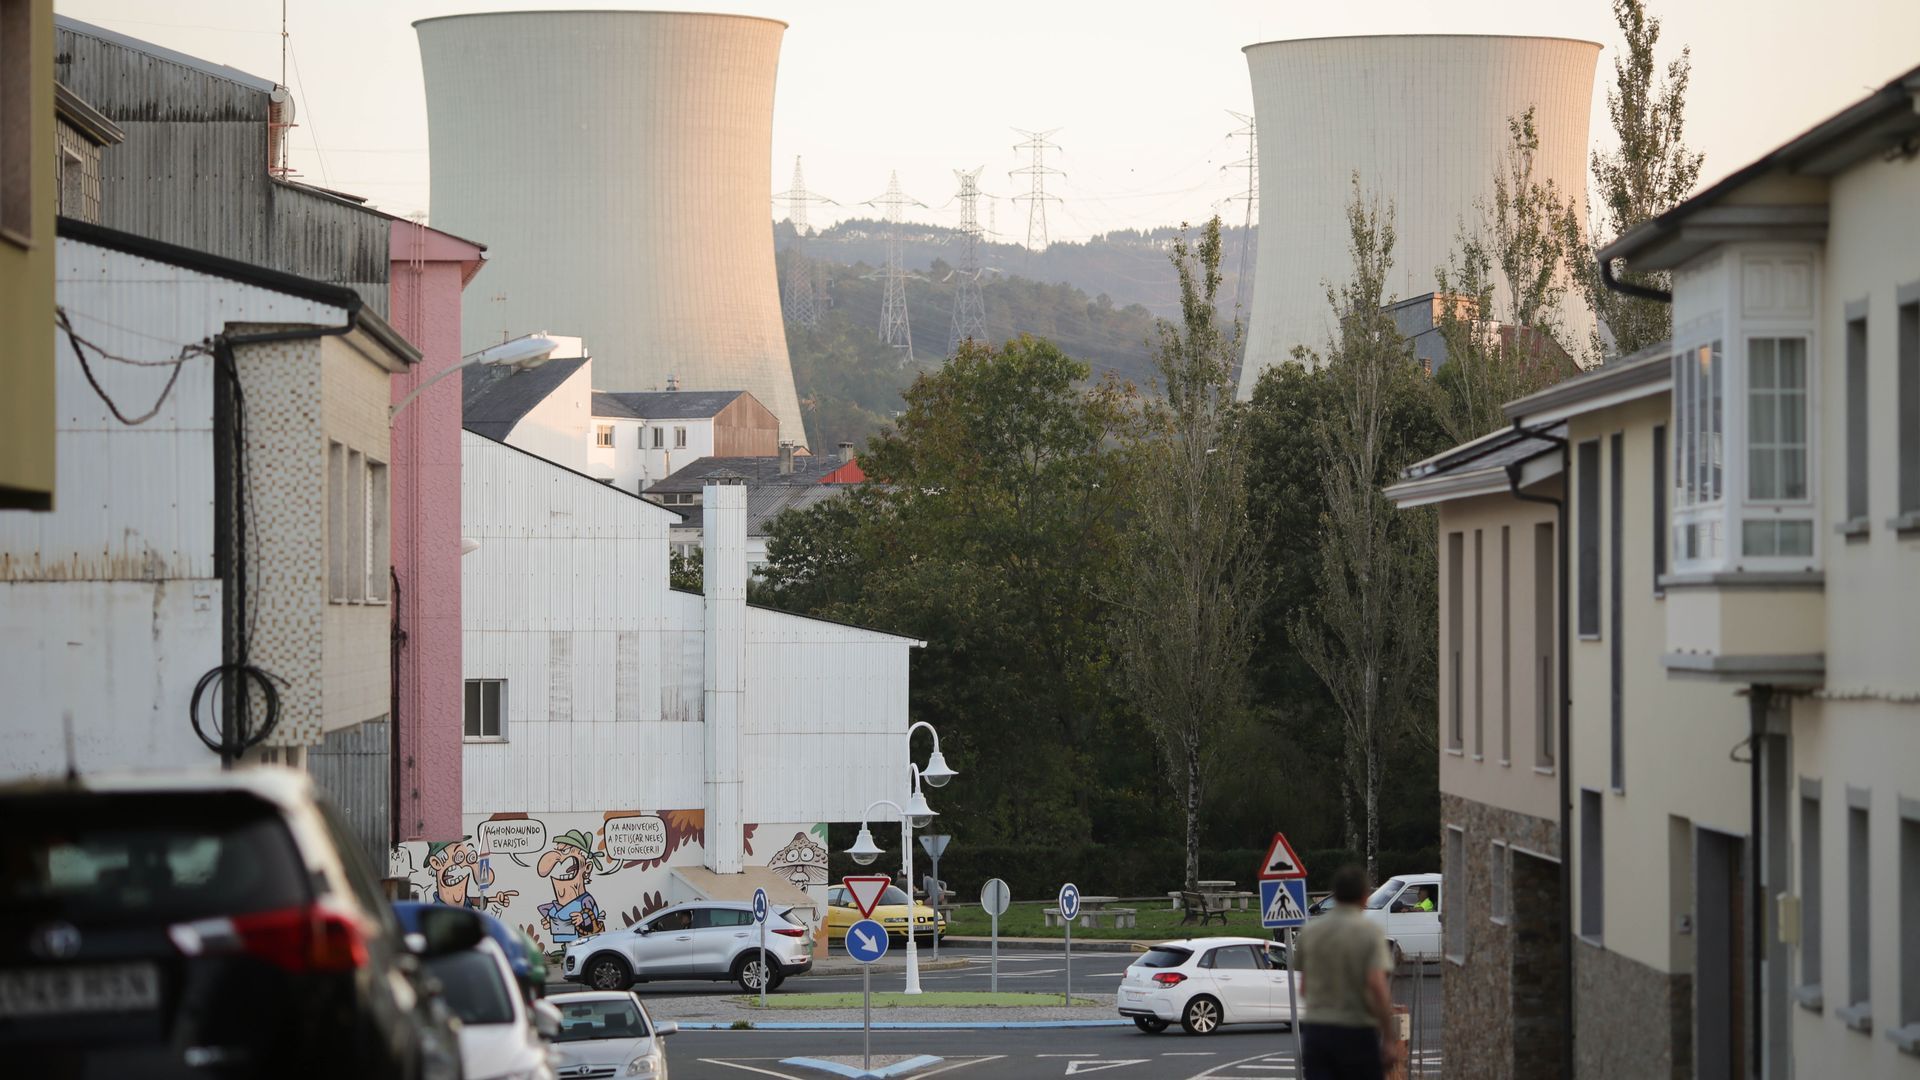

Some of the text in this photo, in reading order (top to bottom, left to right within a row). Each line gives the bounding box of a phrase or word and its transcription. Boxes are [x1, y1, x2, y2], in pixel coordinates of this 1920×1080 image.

[611, 823, 620, 831] XA
[608, 835, 613, 843] A
[645, 833, 664, 844] NELES
[613, 846, 626, 856] SEN
